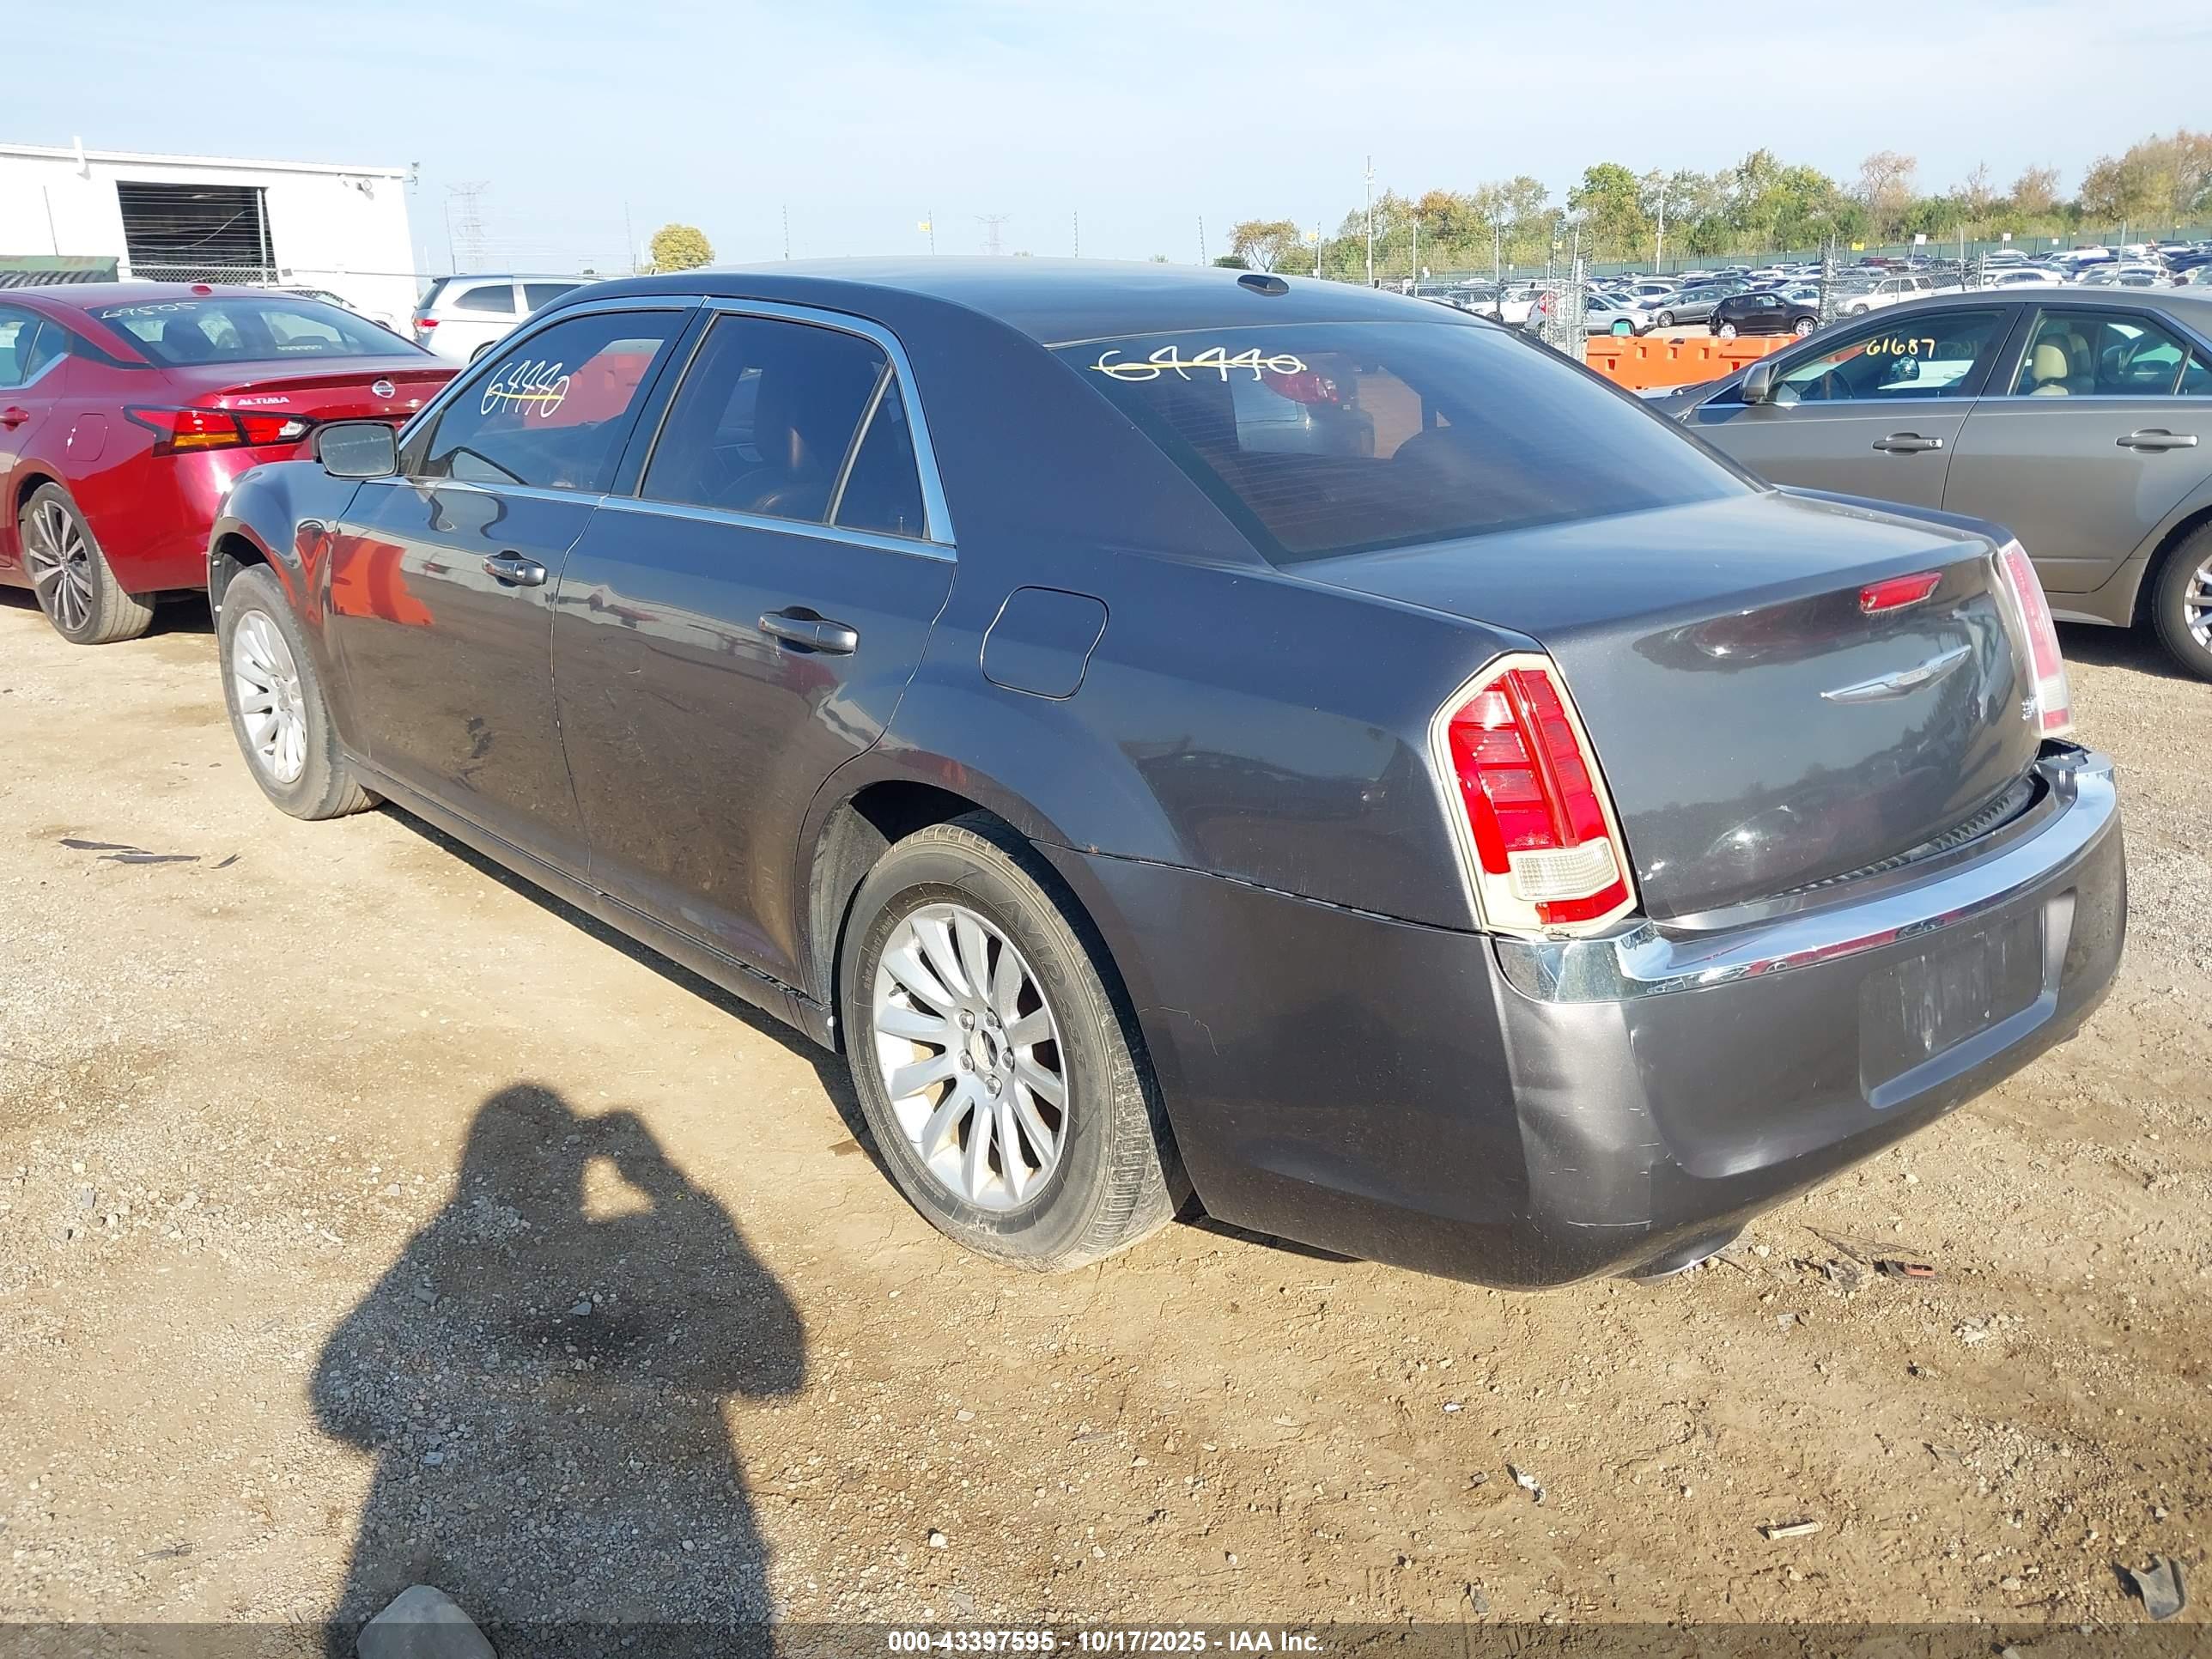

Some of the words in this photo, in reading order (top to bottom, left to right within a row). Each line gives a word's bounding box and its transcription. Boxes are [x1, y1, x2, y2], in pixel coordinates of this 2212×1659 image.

[1097, 344, 1304, 382] 64440
[1866, 337, 1936, 359] 61687
[236, 396, 290, 406] ALTIMA
[481, 360, 569, 418] 64440
